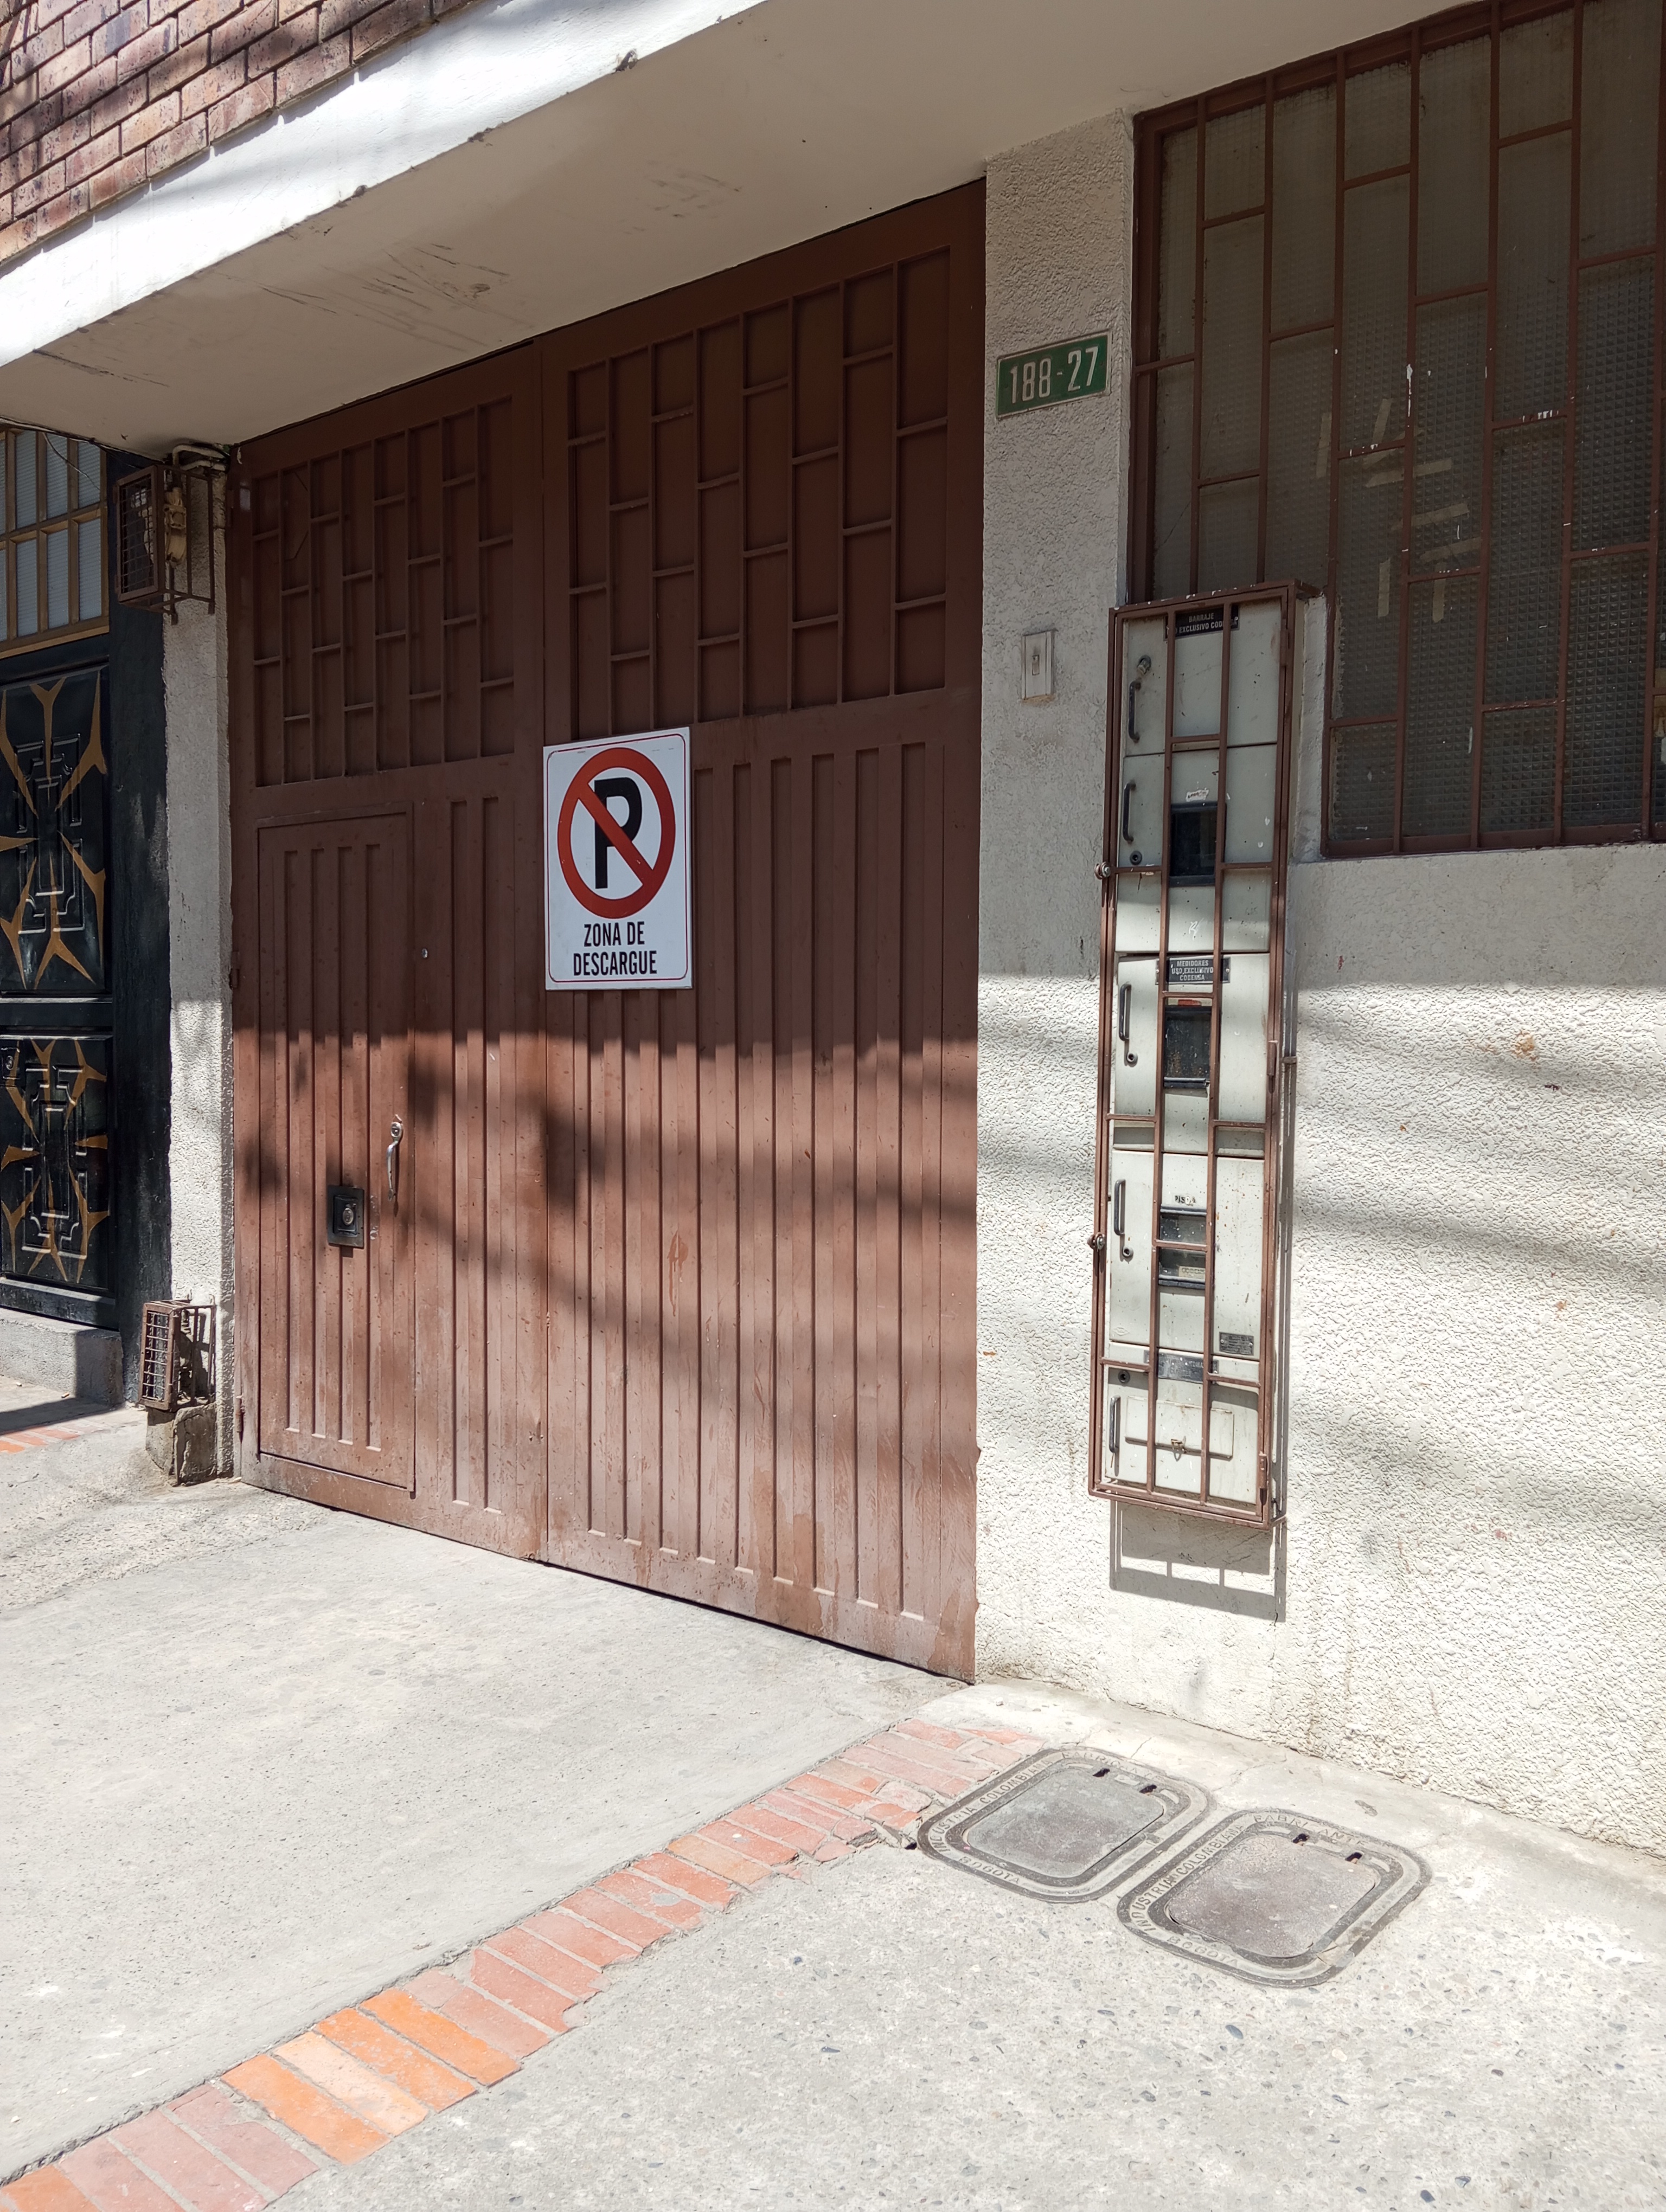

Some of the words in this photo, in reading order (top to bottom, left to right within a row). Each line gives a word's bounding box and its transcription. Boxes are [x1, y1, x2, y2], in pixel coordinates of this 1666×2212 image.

[1010, 346, 1099, 404] 188-27
[1179, 622, 1209, 633] EXCLUSIVO
[1188, 613, 1214, 623] BARRAJE
[584, 923, 621, 947] ZONA
[627, 921, 645, 945] DE
[573, 950, 657, 976] DESCARGUE
[979, 1759, 1053, 1804] COLOMBIANA
[1131, 1875, 1177, 1931] INDUSTRIA
[1176, 1824, 1244, 1875] COLOMBIANA
